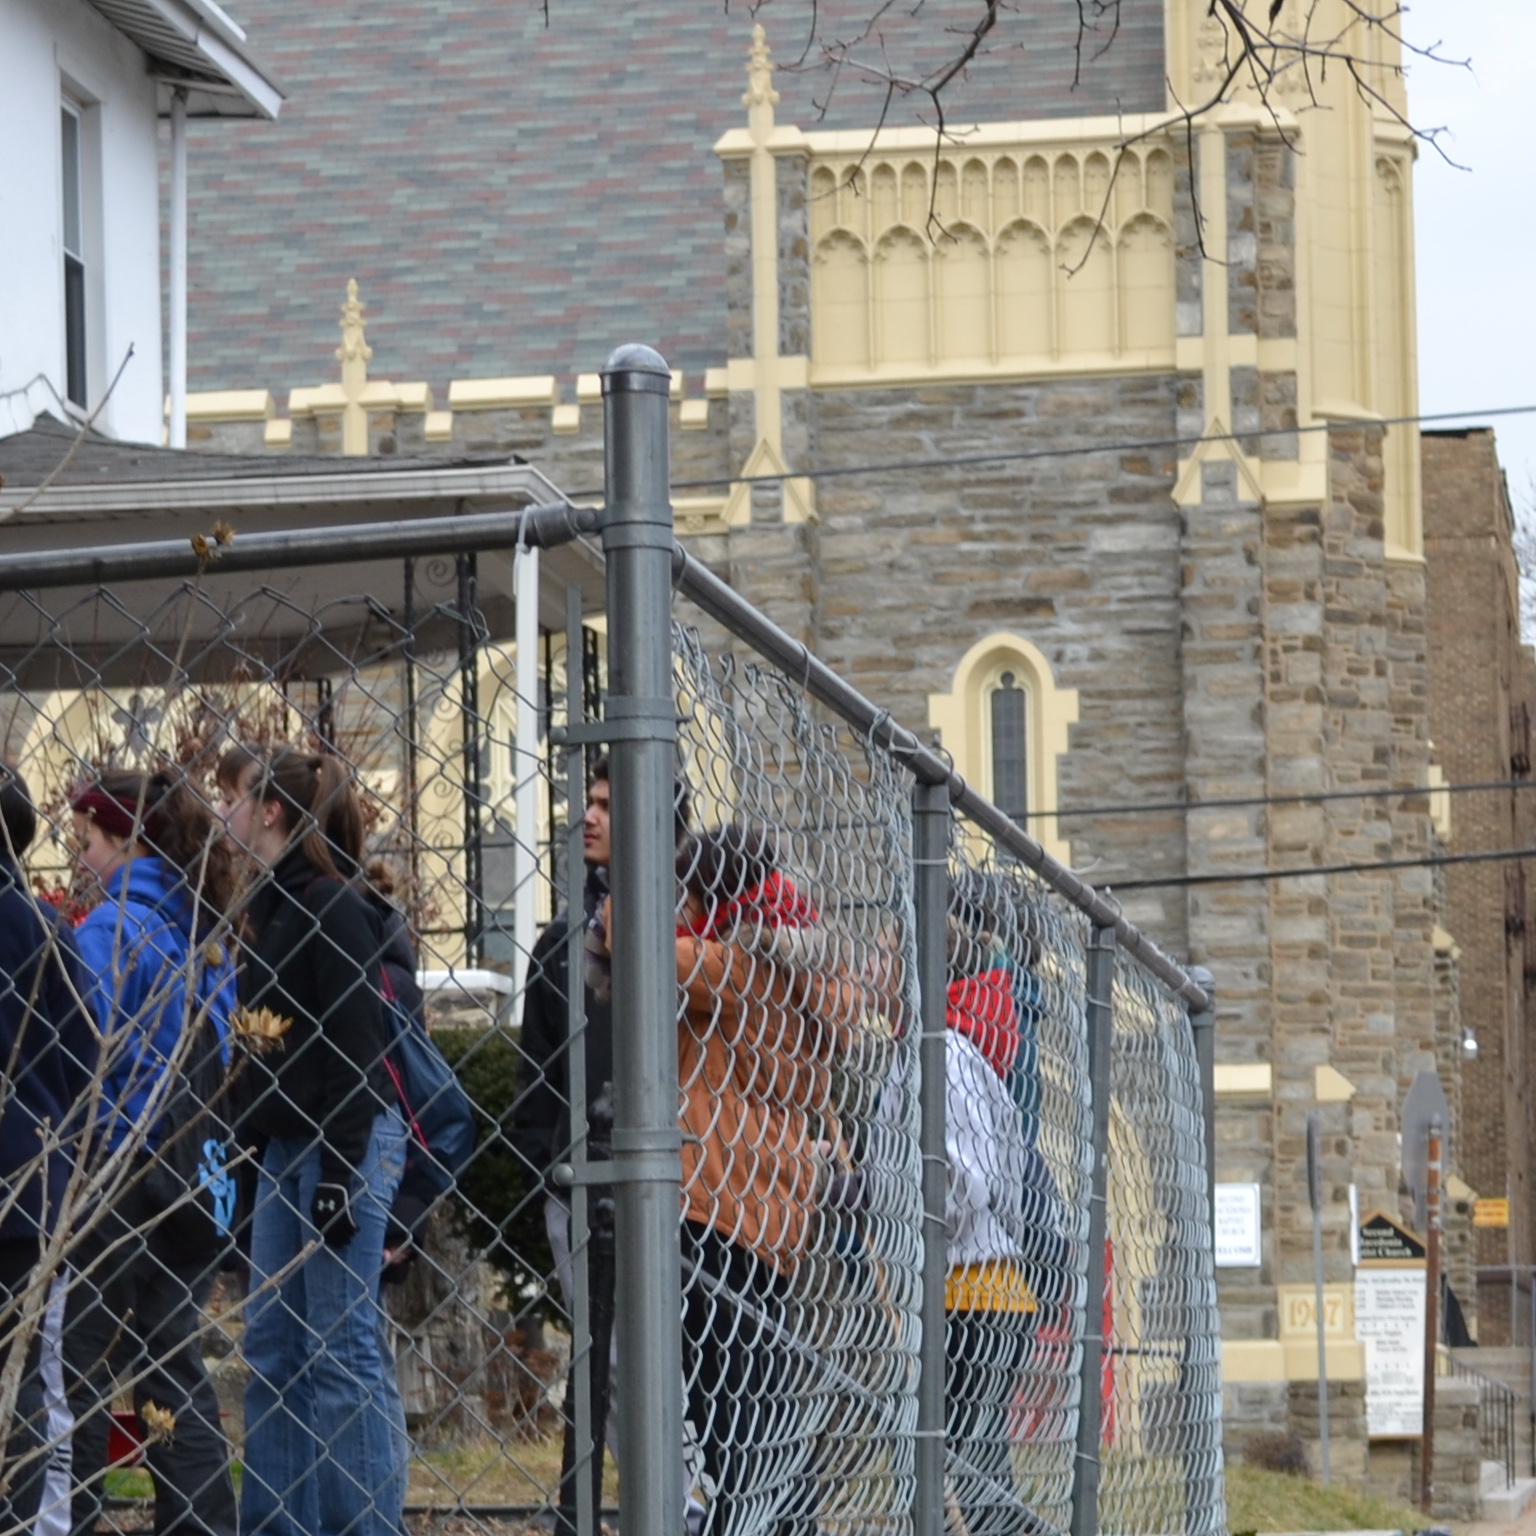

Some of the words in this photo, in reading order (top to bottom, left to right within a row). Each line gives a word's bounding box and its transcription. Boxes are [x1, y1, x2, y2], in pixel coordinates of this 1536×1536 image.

[1362, 1227, 1394, 1237] Second
[1378, 1247, 1412, 1257] Church
[1290, 1298, 1341, 1327] 1907
